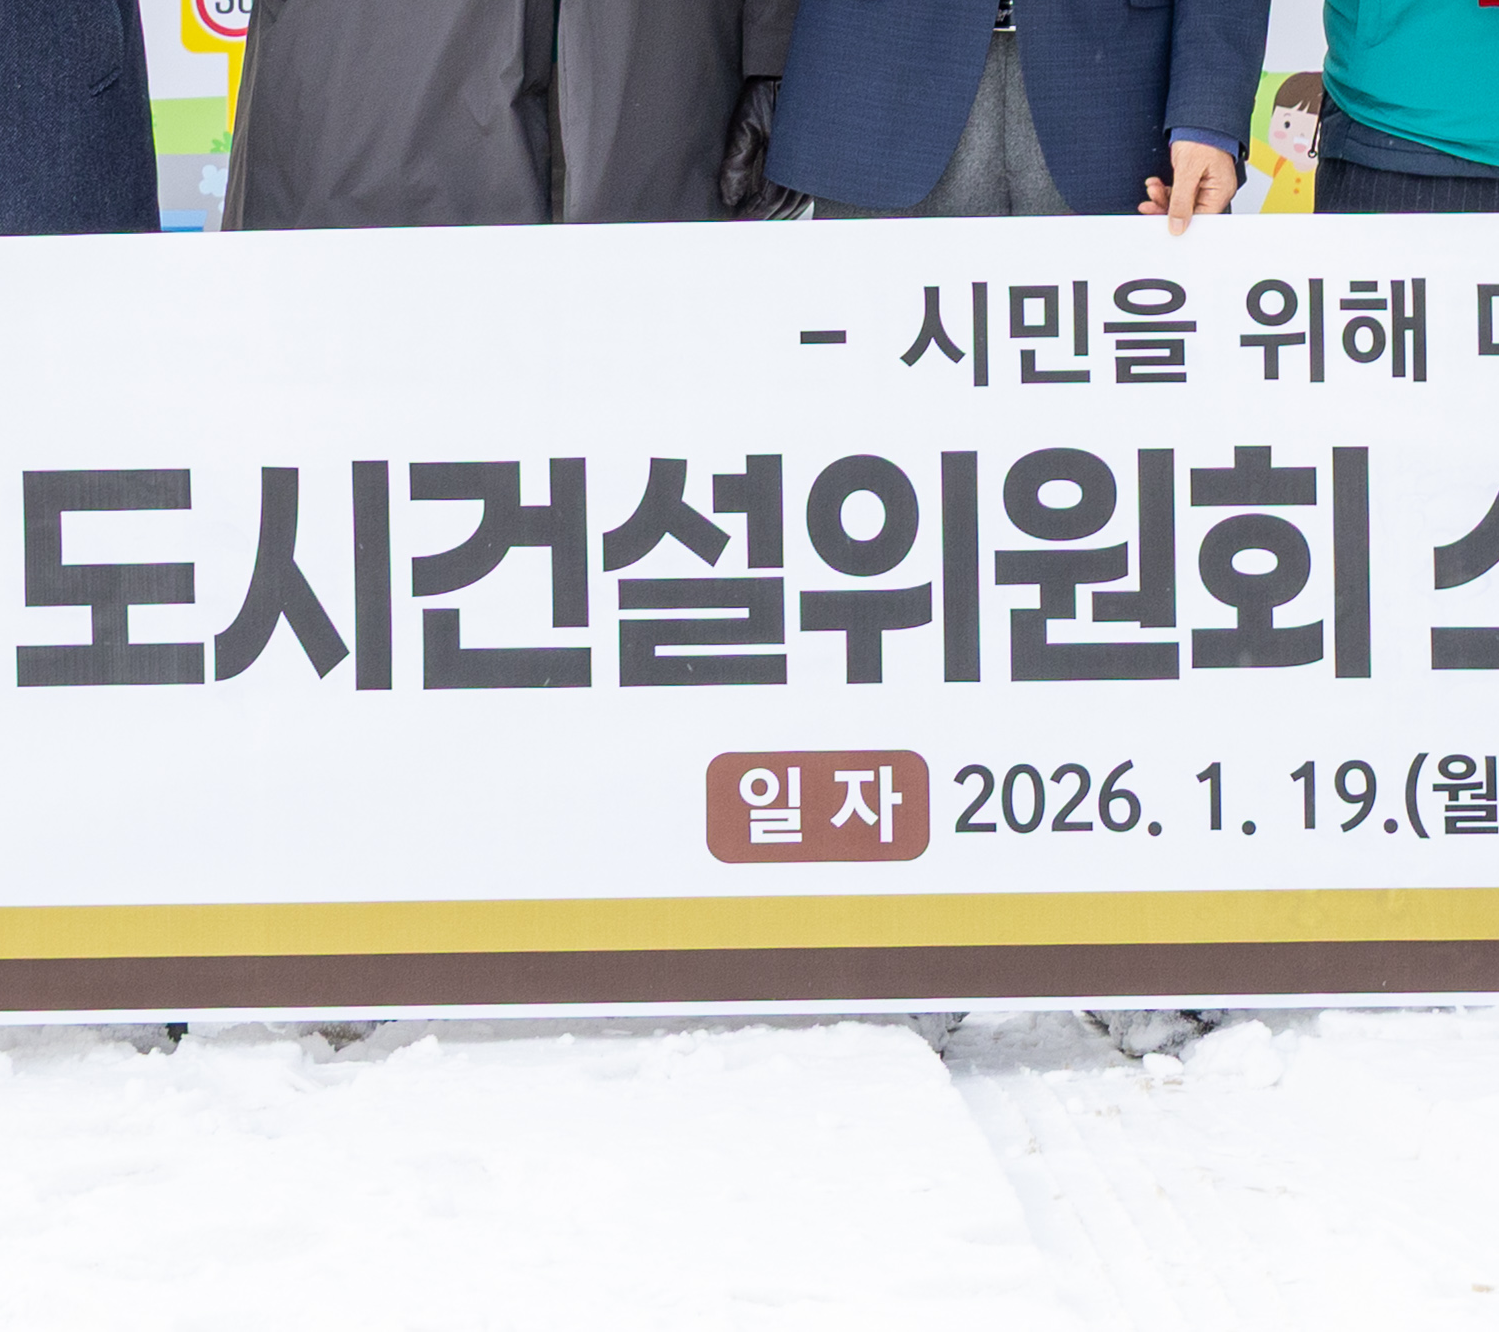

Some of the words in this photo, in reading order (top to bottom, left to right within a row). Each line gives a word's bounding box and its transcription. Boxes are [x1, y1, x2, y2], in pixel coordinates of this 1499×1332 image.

[899, 277, 1198, 388] 시민을
[1239, 277, 1428, 384] 위해
[15, 444, 1373, 692] 도시건설위원회
[952, 759, 1163, 838] 2026.
[1195, 761, 1257, 837] 1.
